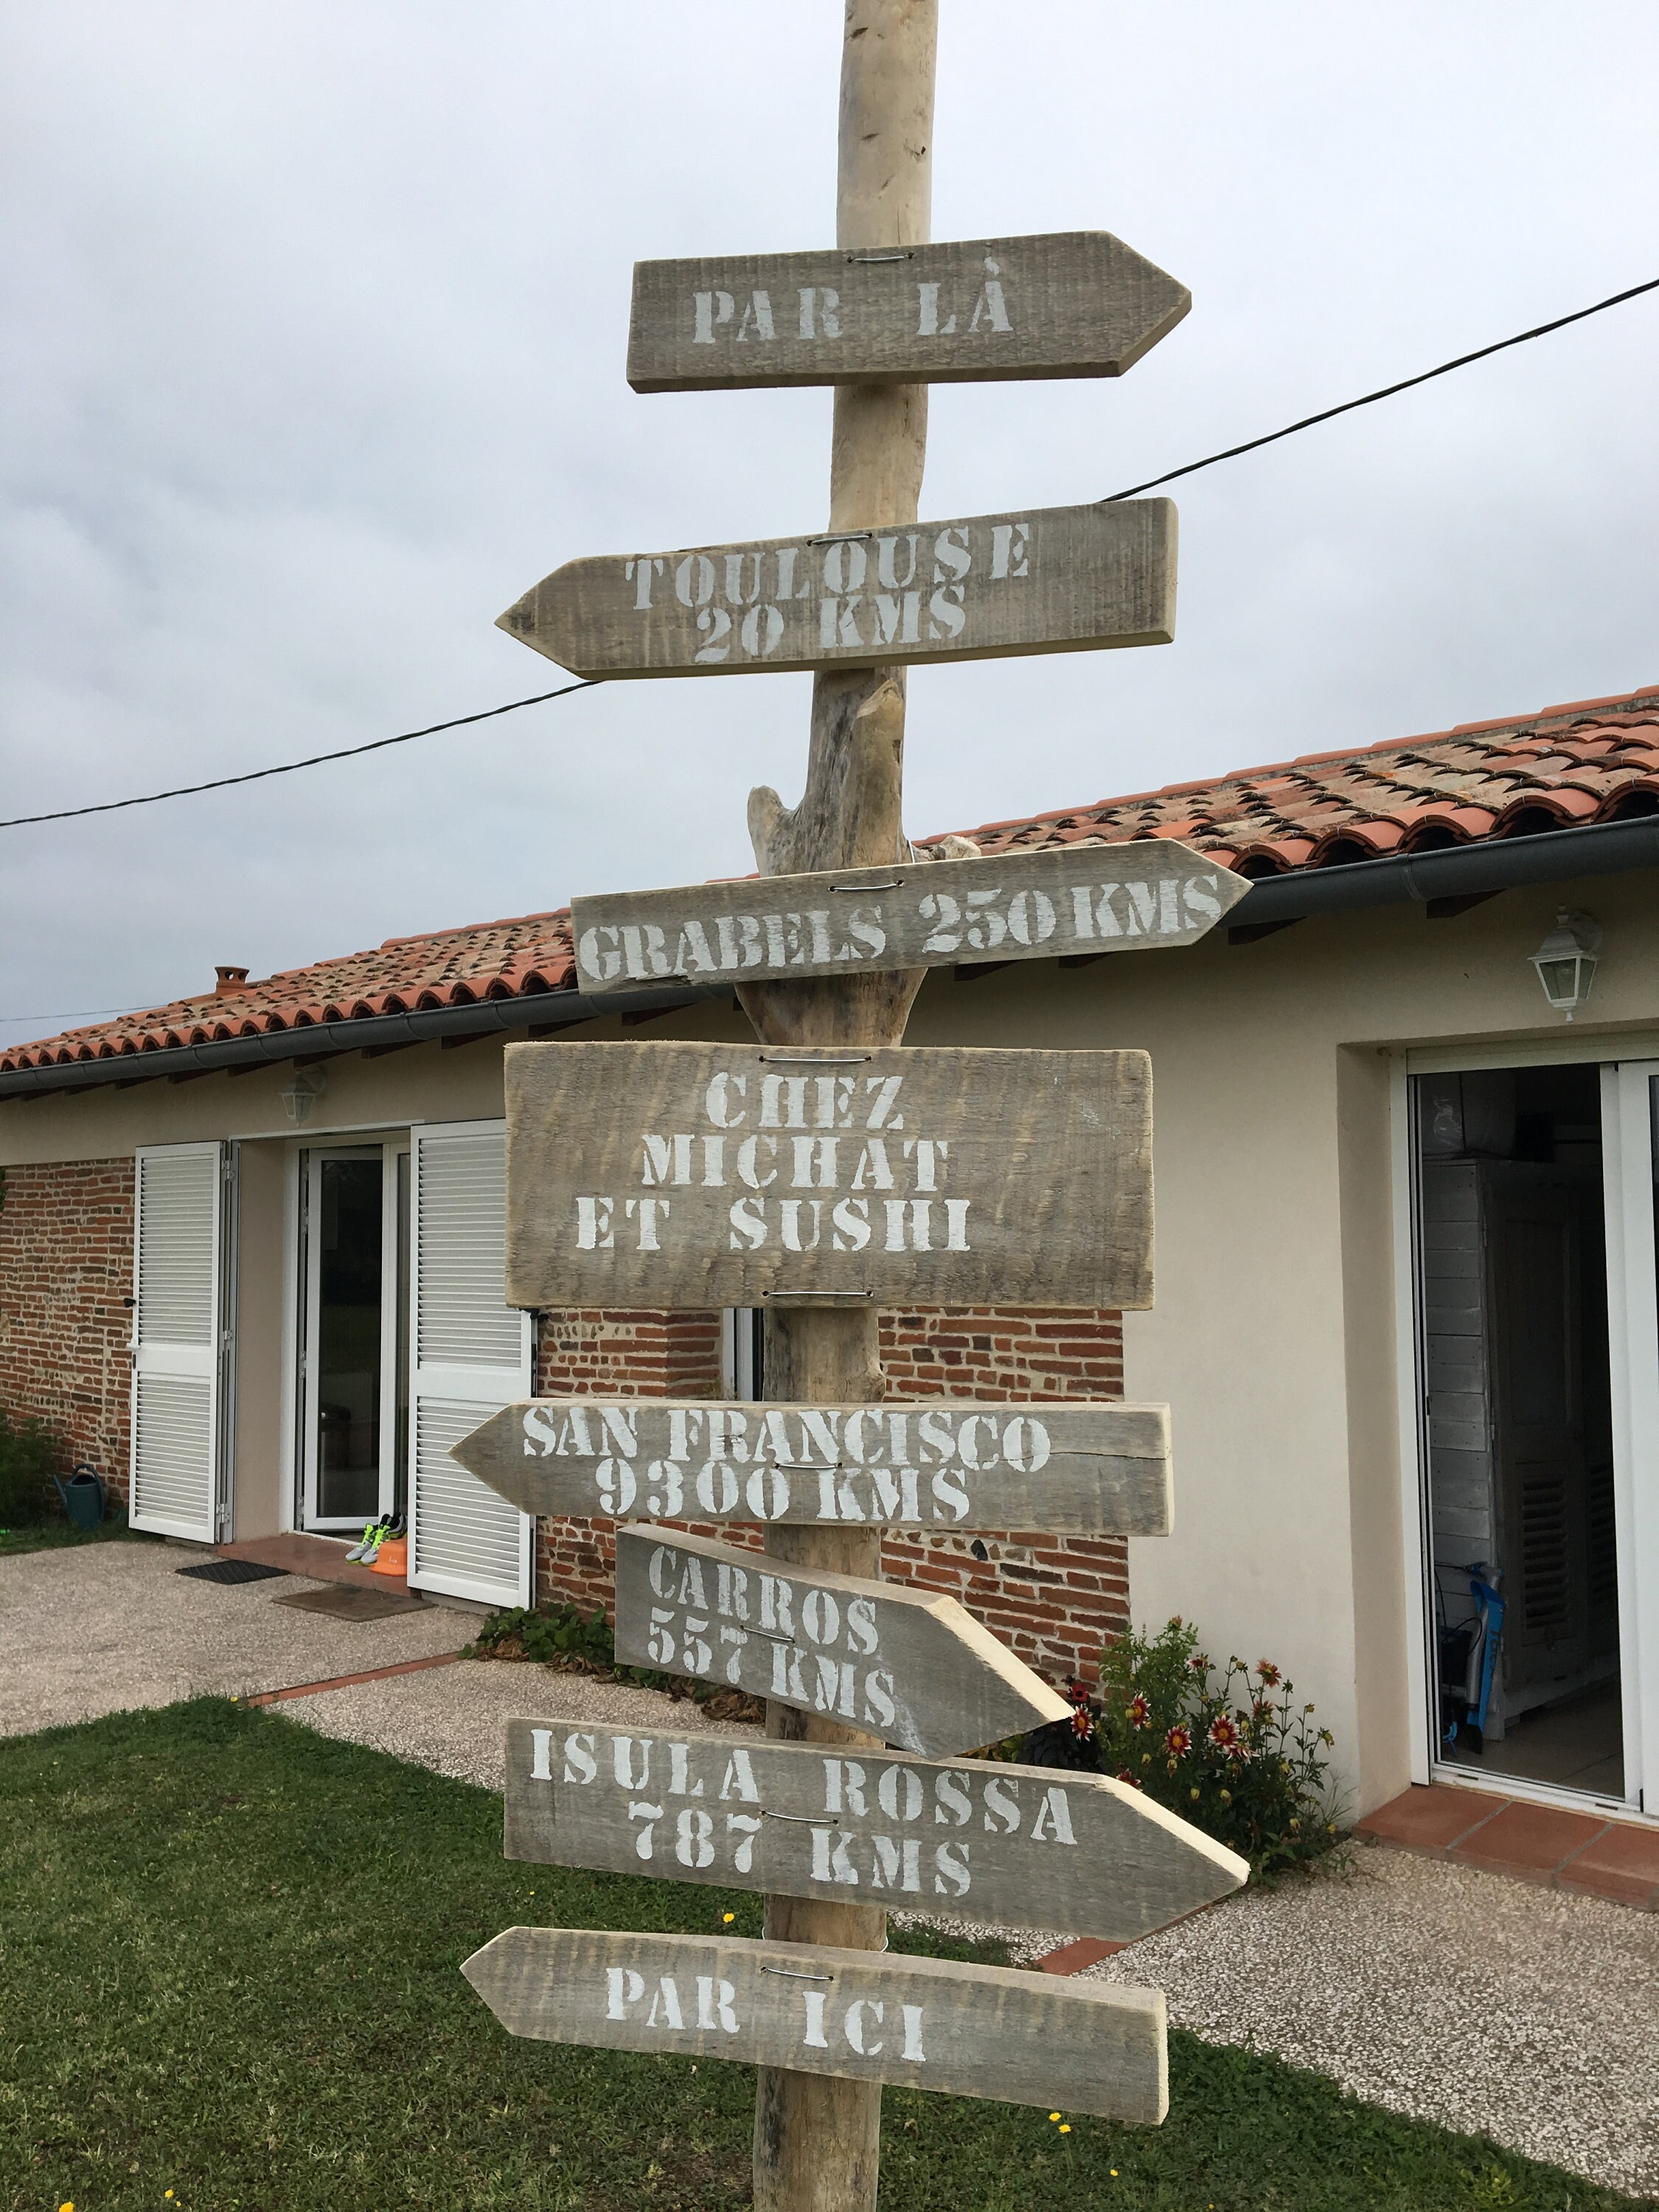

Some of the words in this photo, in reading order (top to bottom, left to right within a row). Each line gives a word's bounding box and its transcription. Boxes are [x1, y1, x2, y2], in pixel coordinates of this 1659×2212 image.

[692, 288, 843, 344] PAR
[917, 256, 1014, 335] LÀ
[625, 524, 1029, 610] TOULOUSE
[695, 604, 785, 664] 20
[819, 586, 965, 649] KMS
[579, 905, 886, 981] GRABELS
[919, 888, 1057, 954] 250
[1071, 874, 1221, 942] KMS
[706, 1071, 903, 1130] CHEZ
[642, 1134, 948, 1192] MICHAT
[575, 1197, 669, 1251] ET
[729, 1197, 970, 1252] SUSHI
[523, 1405, 640, 1459] SAN
[667, 1408, 1051, 1473] FRANCISCO
[596, 1458, 790, 1521] 9300
[816, 1467, 970, 1523] KMS
[649, 1546, 877, 1656] CARROS
[648, 1607, 742, 1686] 557
[770, 1644, 896, 1728] KMS
[529, 1728, 760, 1804] ISULA
[822, 1759, 1078, 1846] ROSSA
[628, 1801, 762, 1874] 787
[810, 1828, 970, 1898] KMS
[606, 1967, 740, 2034] PAR
[802, 1991, 926, 2064] ICI
